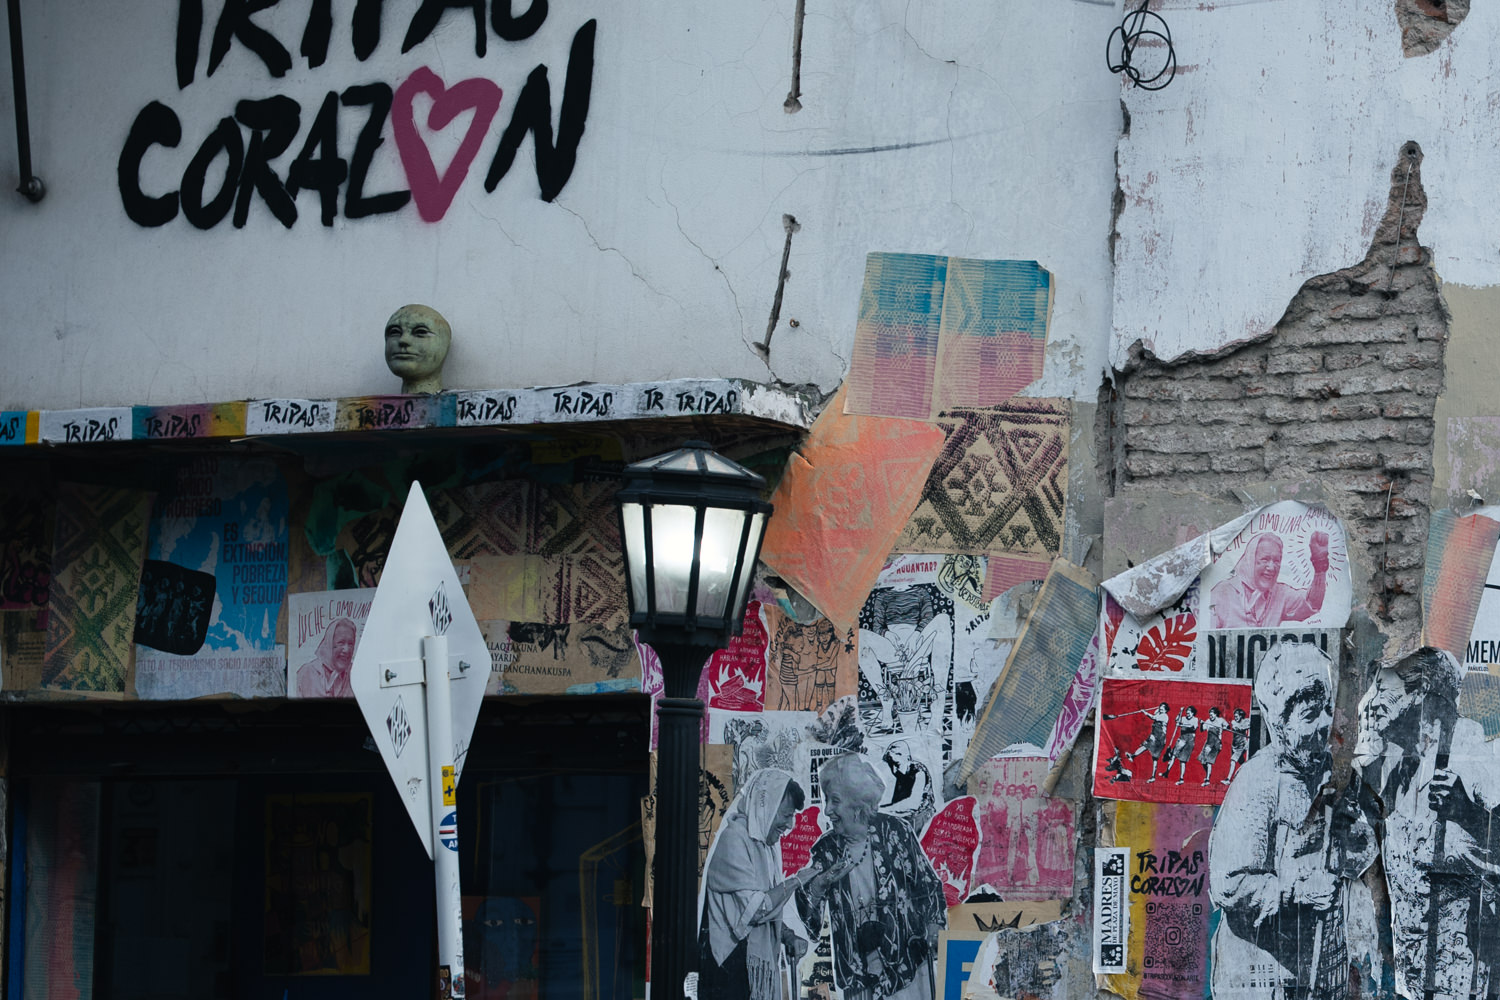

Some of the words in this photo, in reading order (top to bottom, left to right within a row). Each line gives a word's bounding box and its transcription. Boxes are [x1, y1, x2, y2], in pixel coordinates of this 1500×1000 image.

[224, 523, 239, 542] ES
[233, 564, 287, 584] POBREZA
[1137, 850, 1204, 876] TRIPAS
[1101, 877, 1113, 943] MADRES
